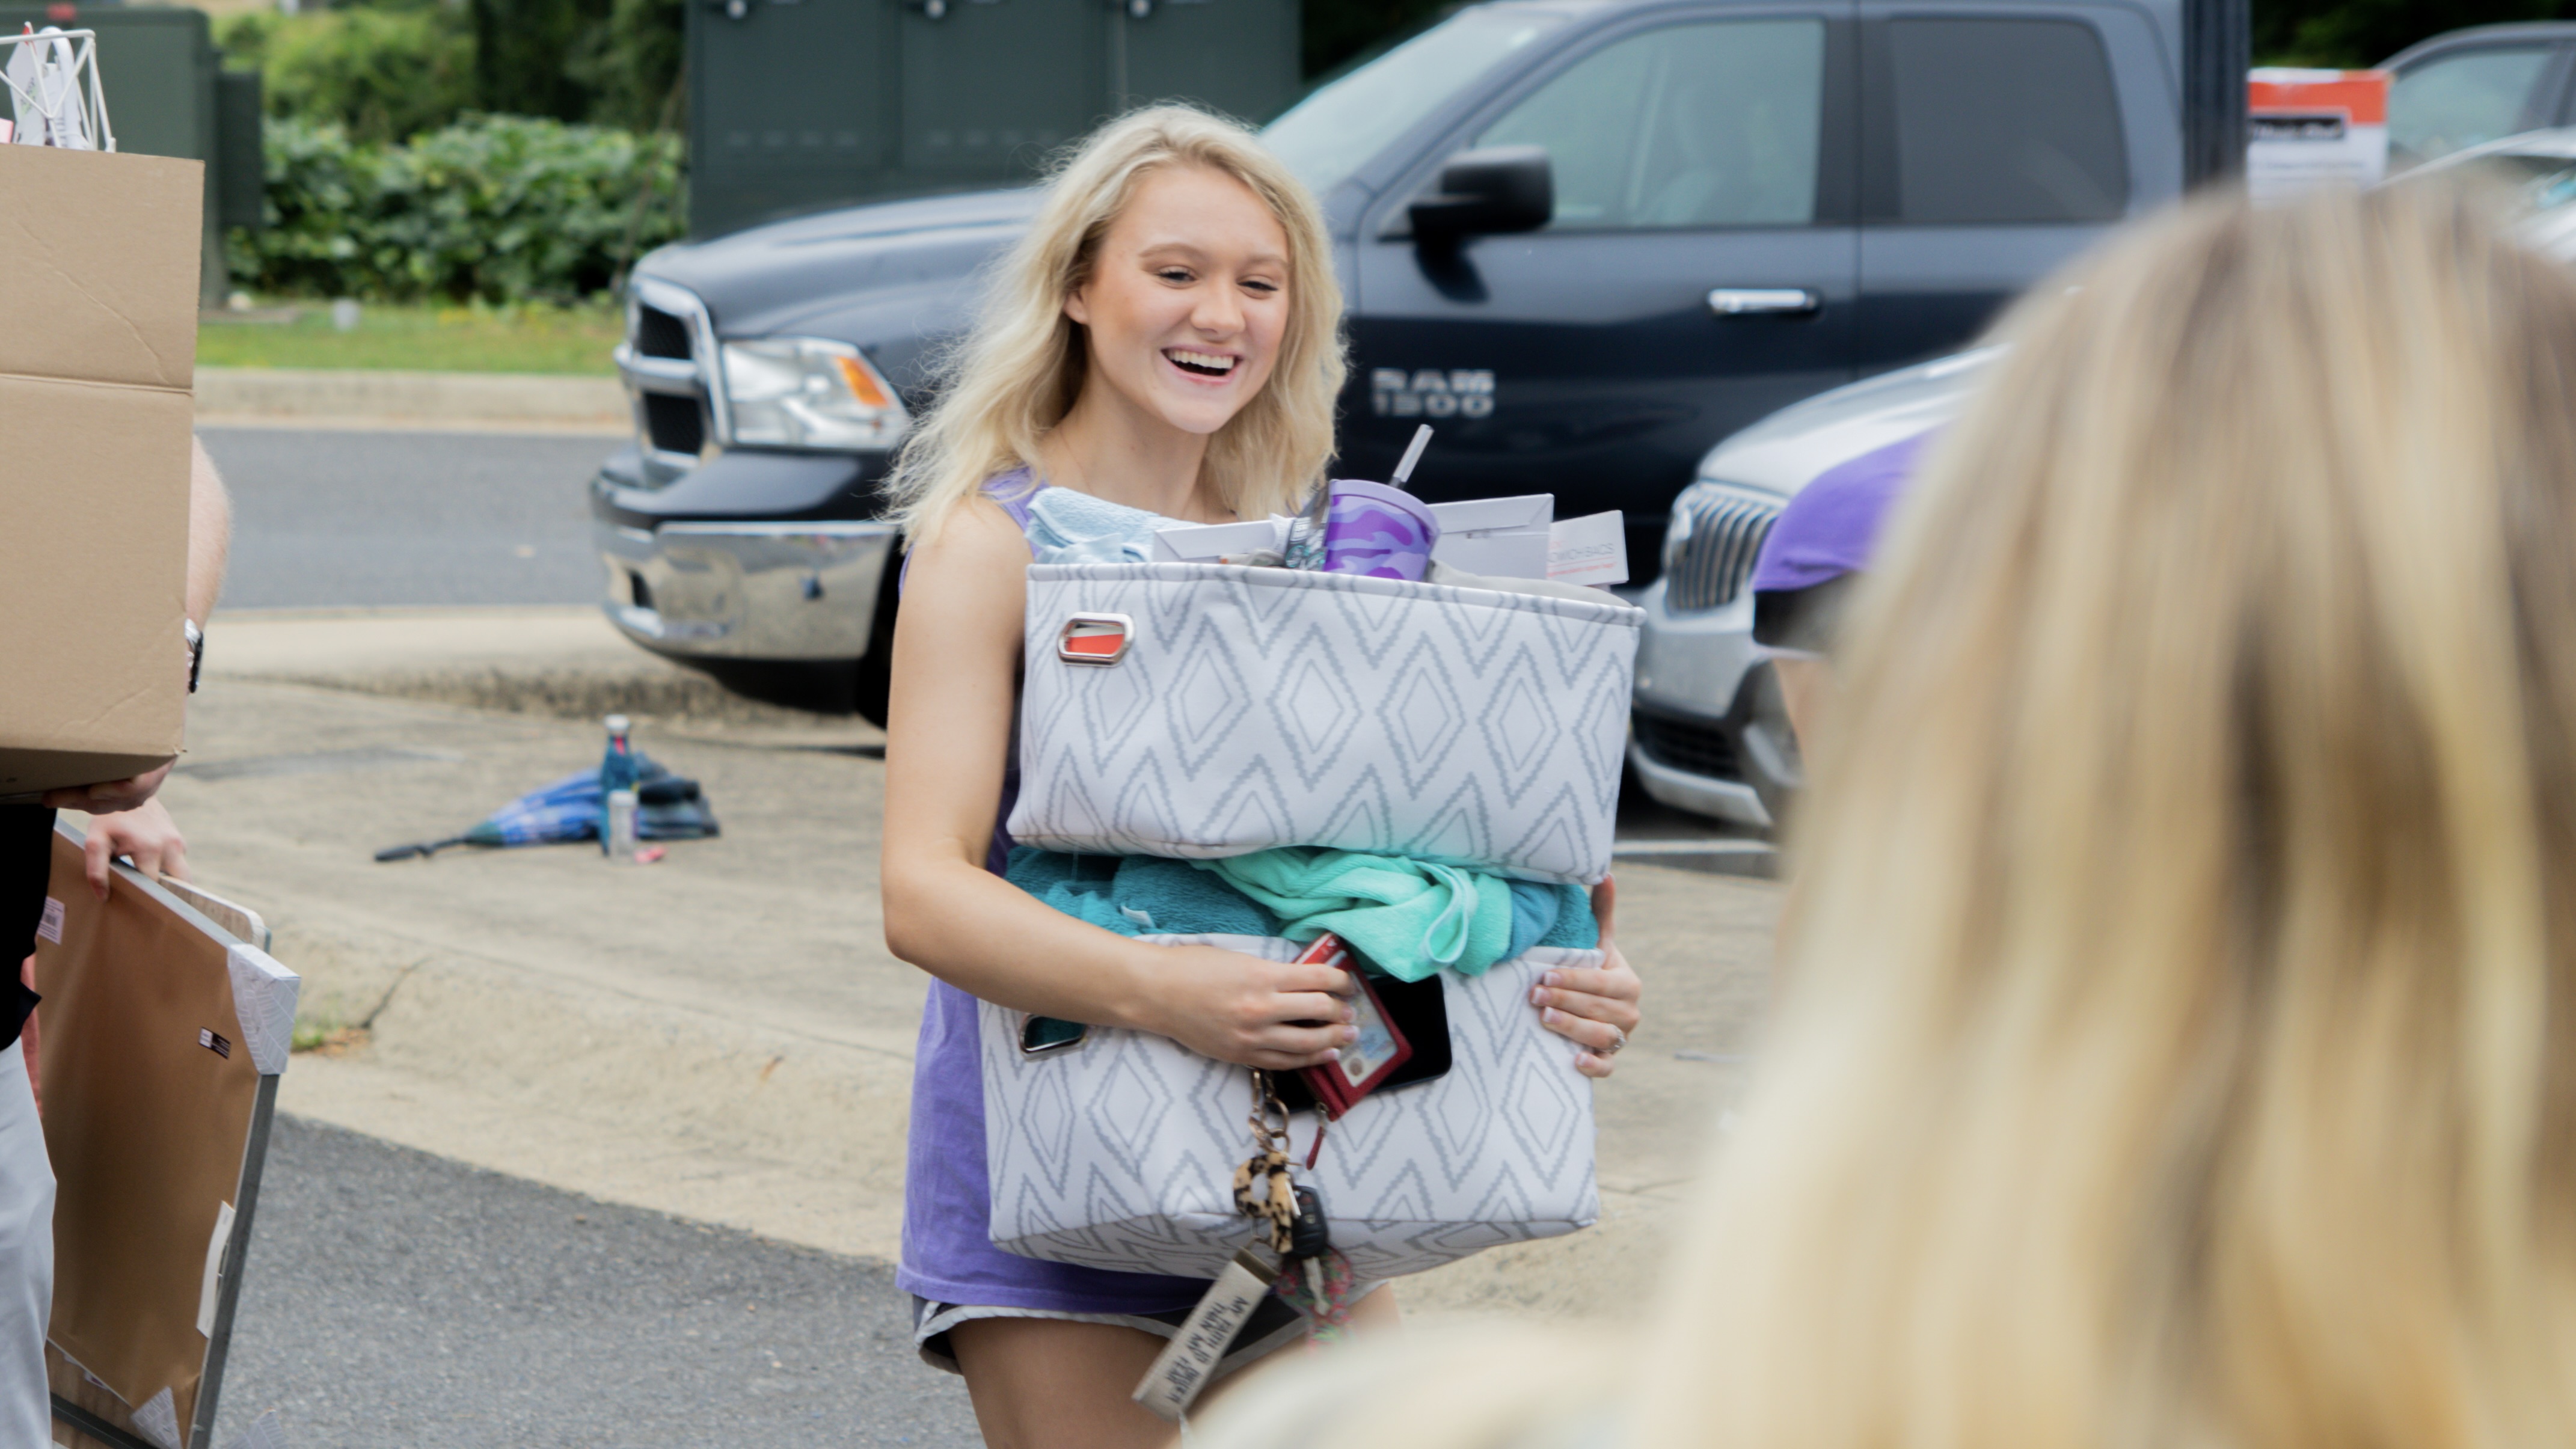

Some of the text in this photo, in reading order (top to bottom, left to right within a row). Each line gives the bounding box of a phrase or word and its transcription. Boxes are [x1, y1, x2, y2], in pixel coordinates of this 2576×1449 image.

[1371, 367, 1495, 392] RAM
[1372, 393, 1495, 417] 1500
[1228, 1296, 1250, 1316] MY
